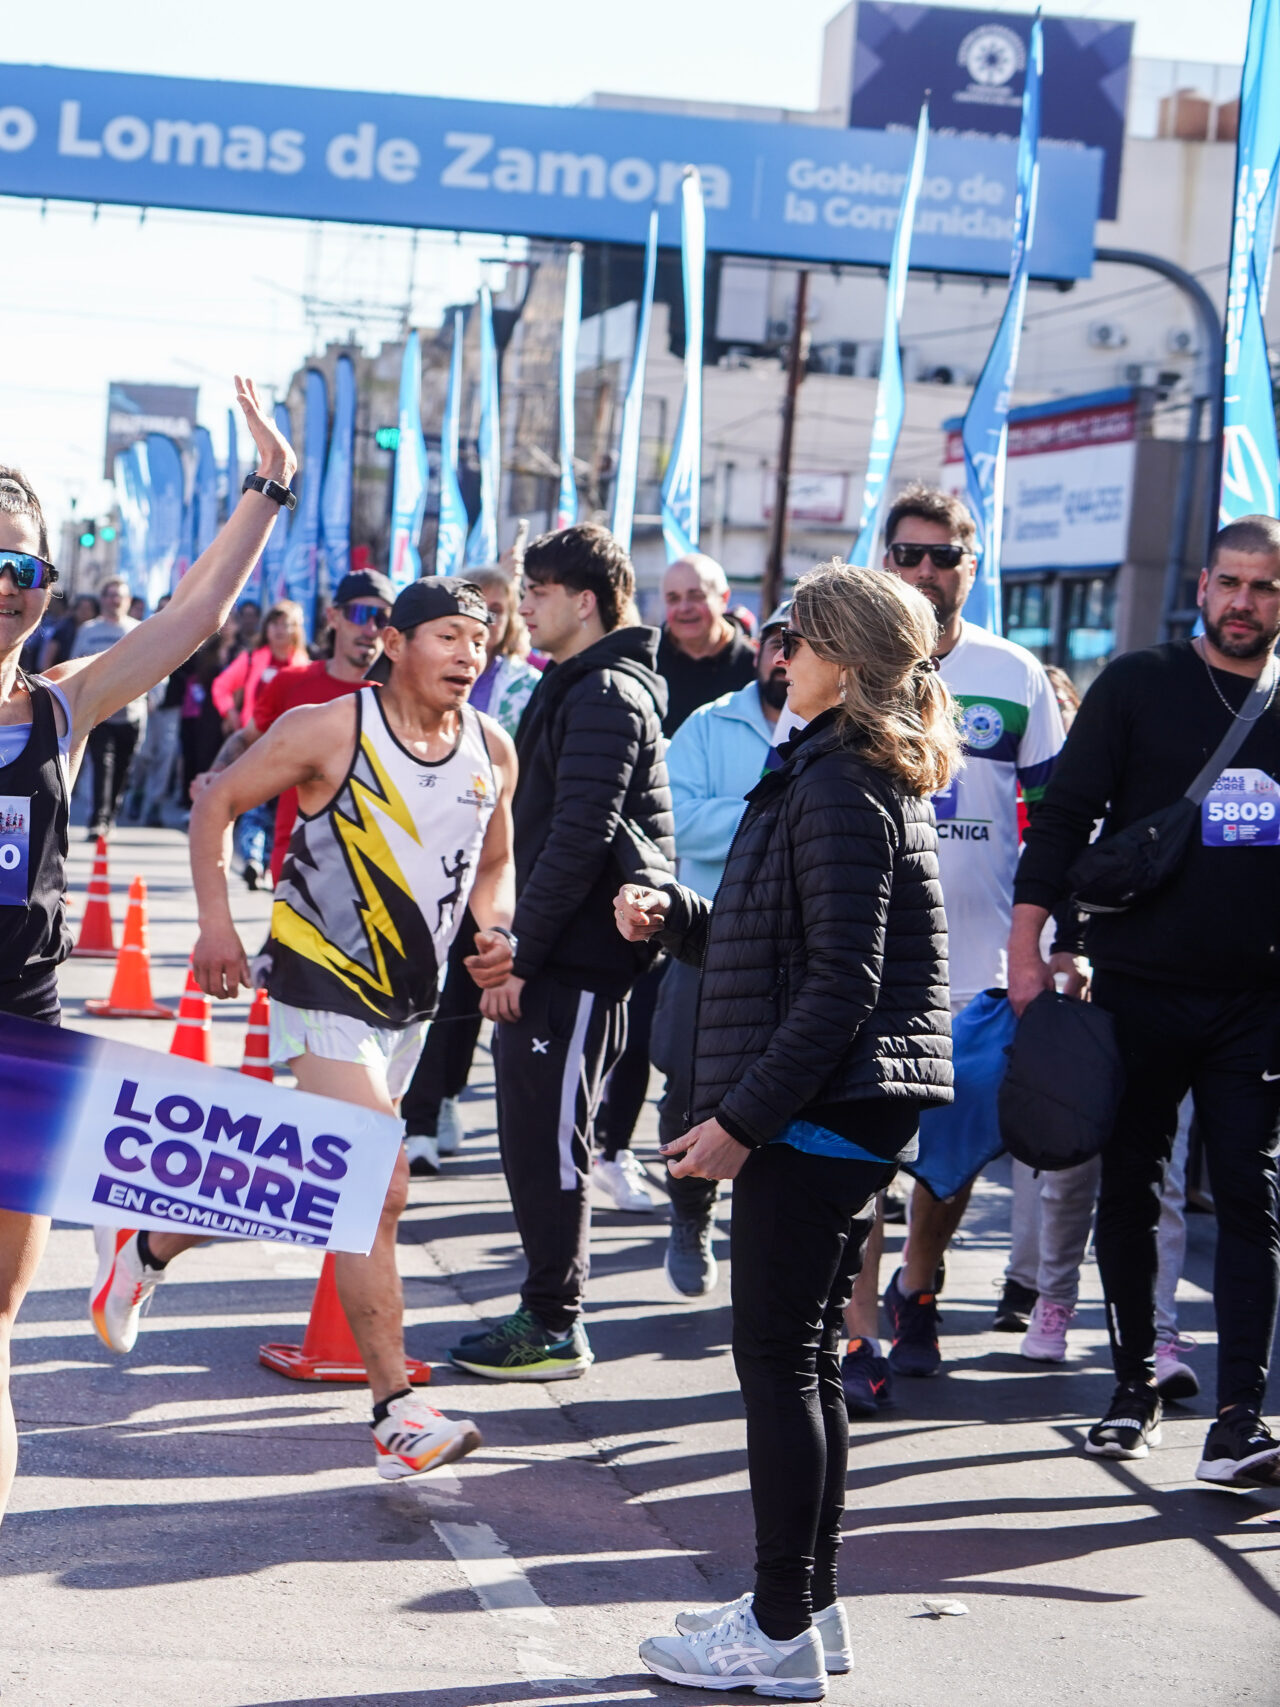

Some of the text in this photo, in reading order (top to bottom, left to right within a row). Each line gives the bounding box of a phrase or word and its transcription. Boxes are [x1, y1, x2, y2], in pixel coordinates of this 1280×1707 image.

[60, 100, 304, 173] Lomas
[326, 123, 420, 183] de
[441, 132, 731, 210] Zamora
[785, 192, 816, 224] la
[958, 172, 1005, 205] de
[1208, 802, 1275, 821] 5809
[113, 1078, 352, 1181] LOMAS
[103, 1125, 341, 1231] CORRE
[107, 1183, 316, 1244] EN COMUNIDAD
